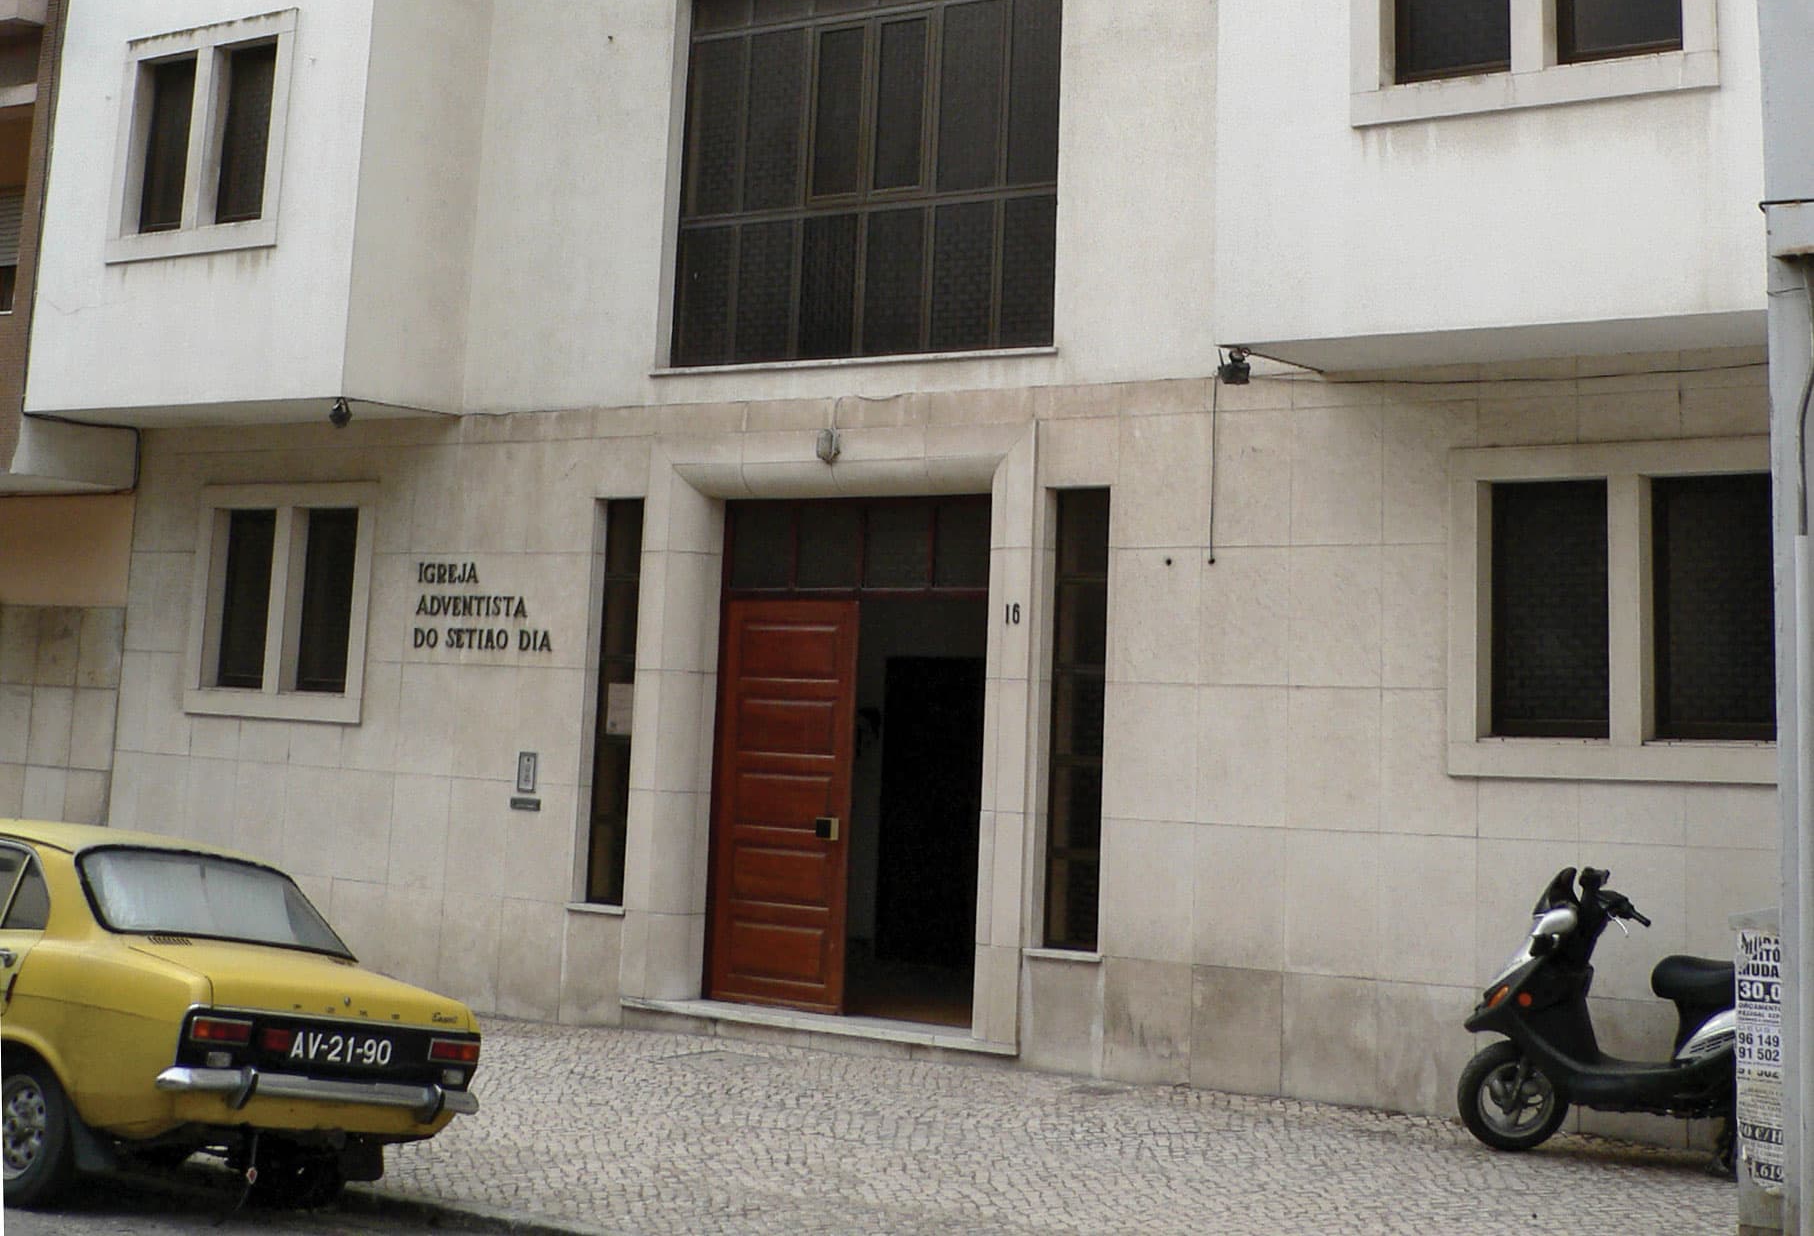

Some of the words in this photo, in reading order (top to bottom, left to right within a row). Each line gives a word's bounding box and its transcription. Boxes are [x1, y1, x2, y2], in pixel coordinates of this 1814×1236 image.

[417, 562, 479, 584] IGREJA
[416, 594, 528, 618] ADVENTISTA
[1005, 602, 1021, 625] 16
[413, 627, 438, 649] DO
[518, 629, 552, 652] DIA
[289, 1031, 392, 1065] AV-21-90
[1738, 1032, 1753, 1045] 96
[1757, 1034, 1780, 1047] 149
[1738, 1046, 1752, 1059] 91
[1757, 1048, 1780, 1062] 502
